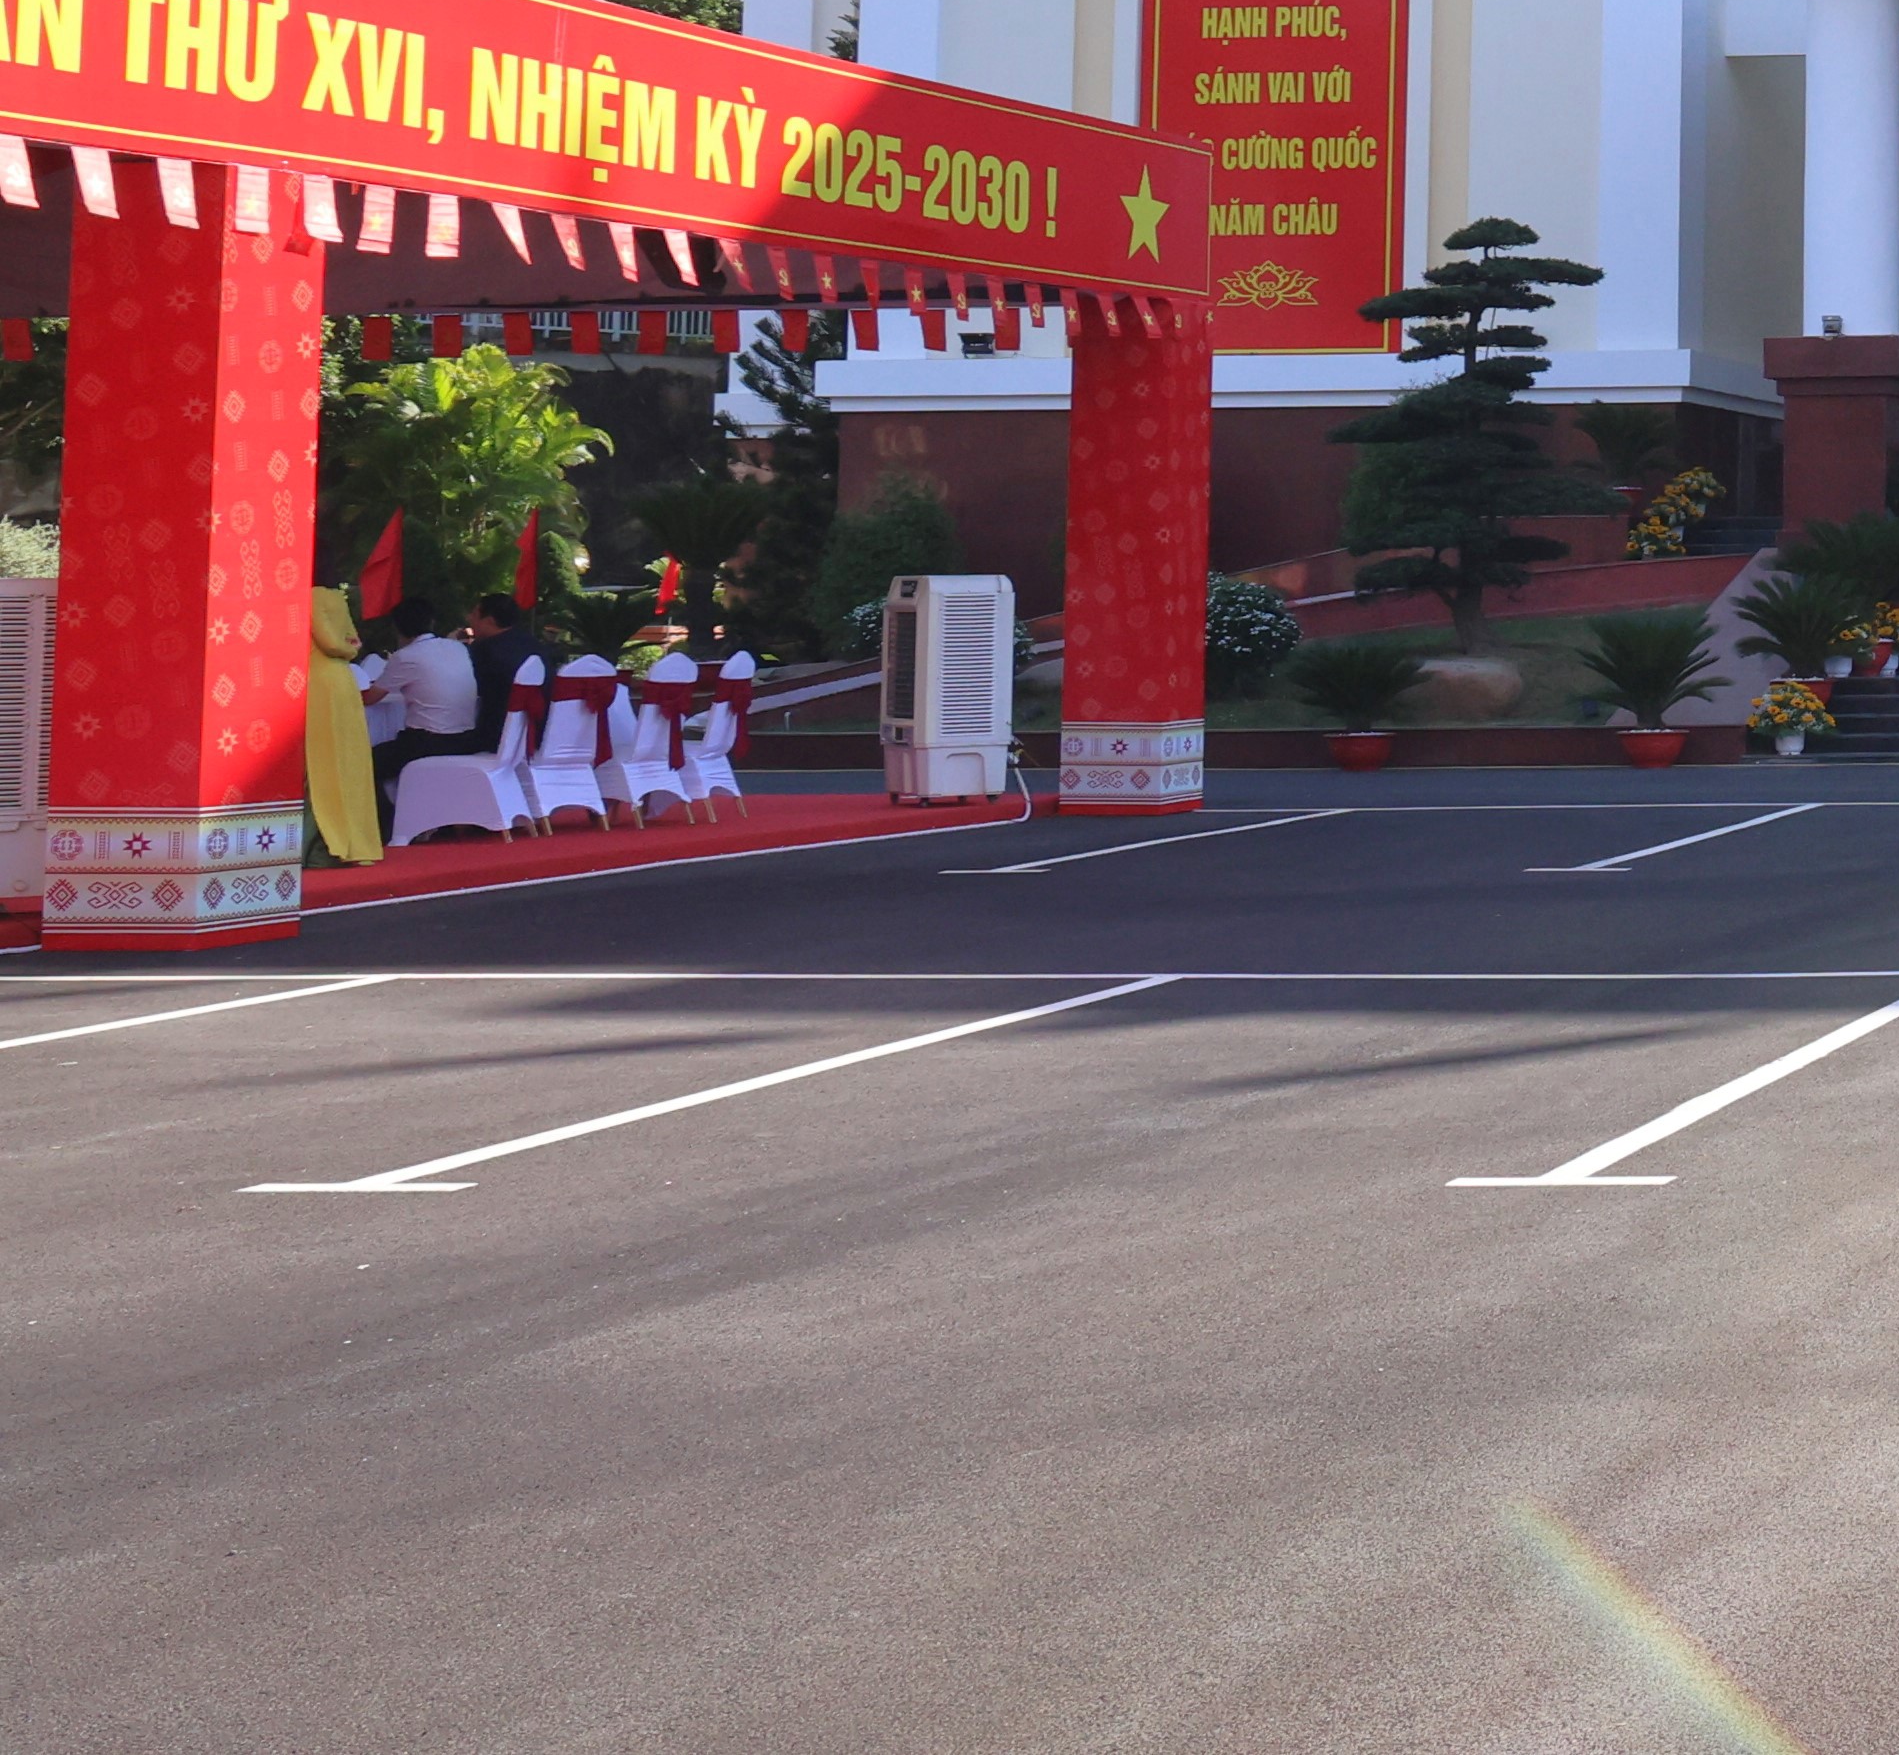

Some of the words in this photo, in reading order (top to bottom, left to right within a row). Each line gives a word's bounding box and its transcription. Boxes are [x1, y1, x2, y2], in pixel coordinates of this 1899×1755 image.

[1203, 7, 1267, 45] HẠNH
[1275, 0, 1346, 40] PHÚC,
[1195, 66, 1260, 104] SÁNH
[1268, 72, 1304, 103] VAI
[1313, 65, 1350, 102] VỚI
[302, 12, 444, 144] XVI,
[469, 54, 677, 182] NHIỆM
[696, 87, 766, 188] KỲ
[780, 115, 1031, 233] 2025-2030
[1046, 167, 1057, 237] !
[1222, 131, 1303, 169] CƯỜNG
[1312, 126, 1376, 172] QUỐC
[1209, 198, 1264, 236] NĂM
[1273, 197, 1337, 235] CHÂU
